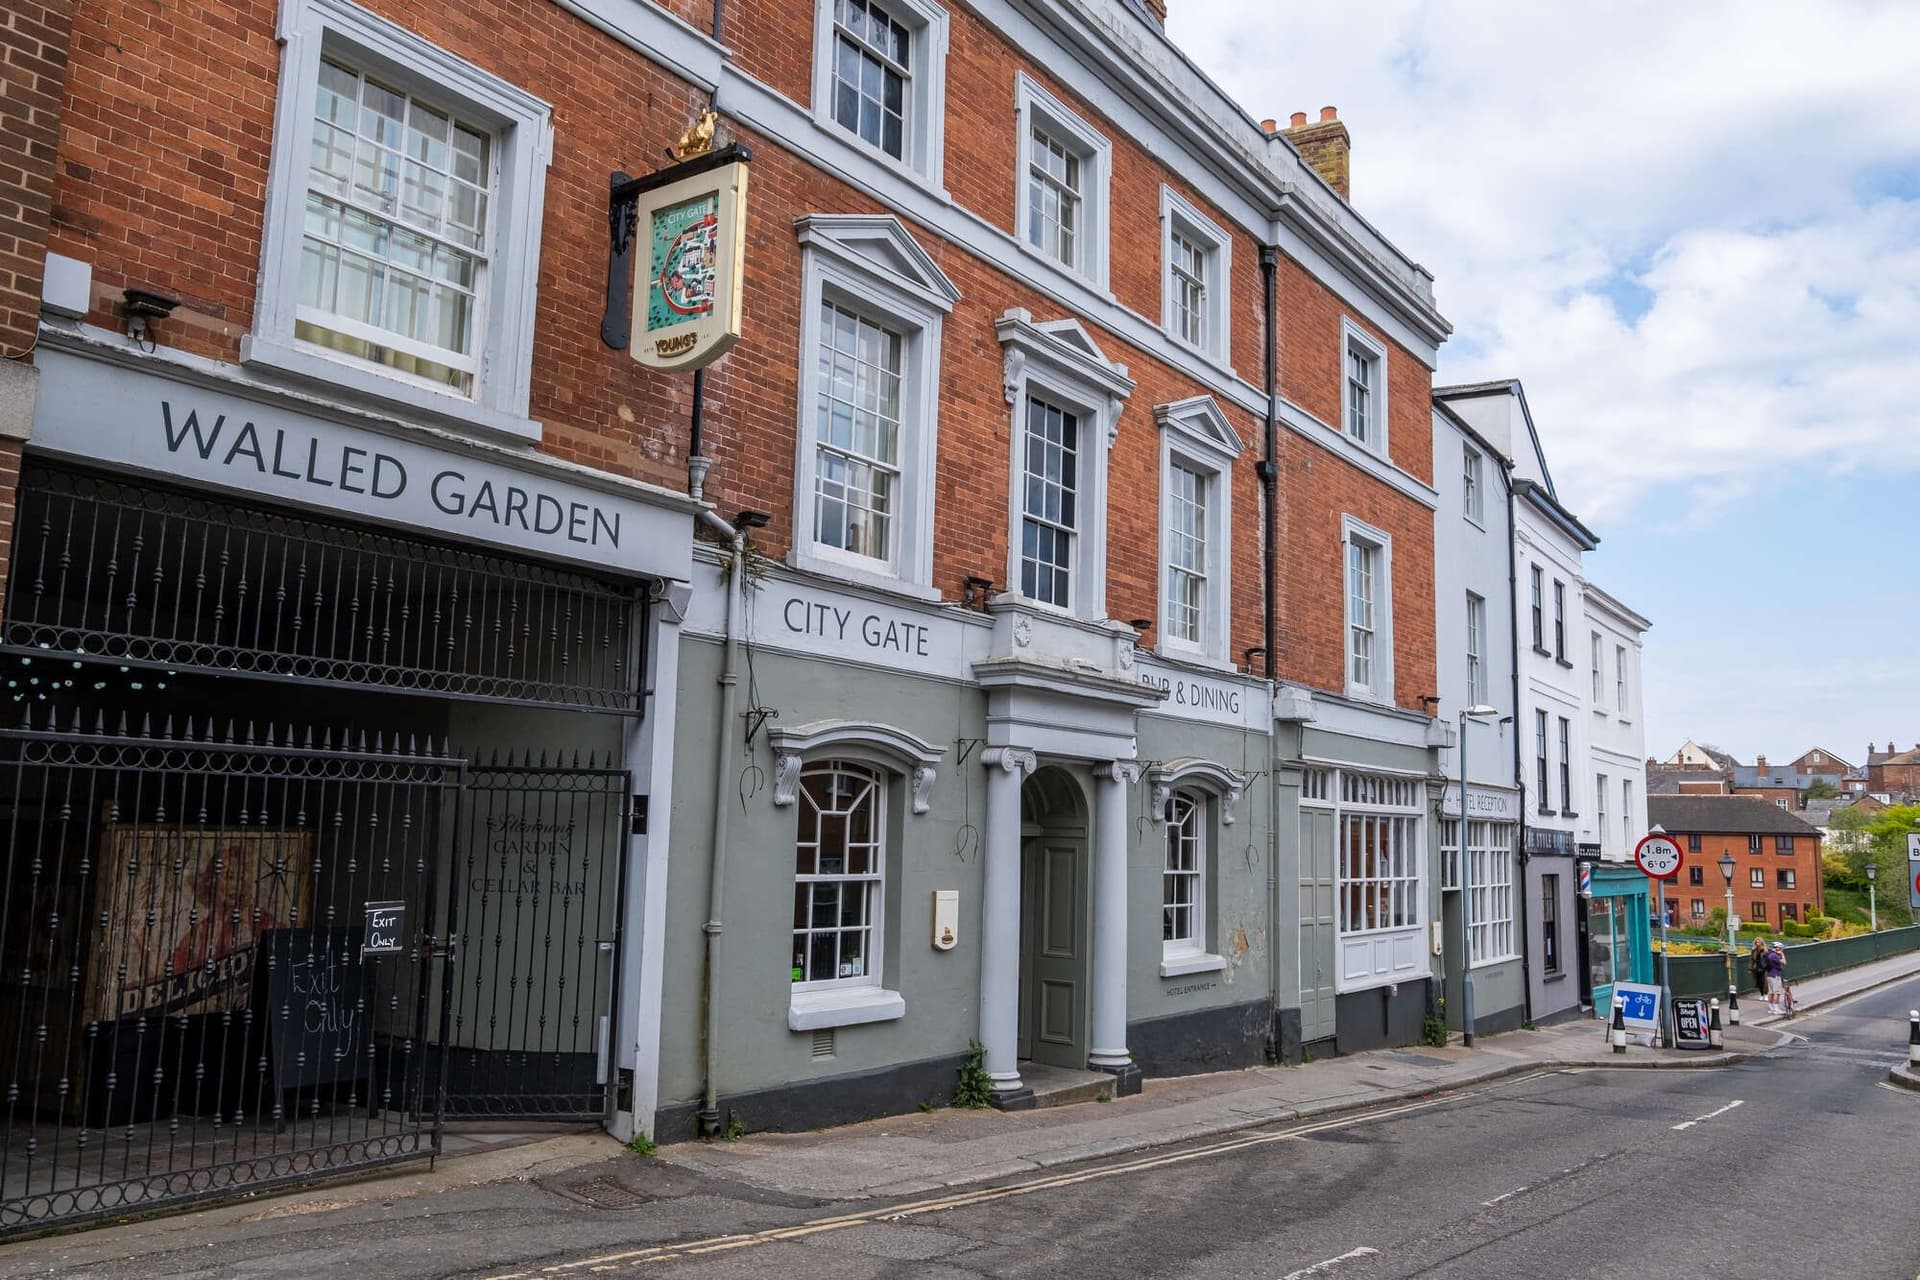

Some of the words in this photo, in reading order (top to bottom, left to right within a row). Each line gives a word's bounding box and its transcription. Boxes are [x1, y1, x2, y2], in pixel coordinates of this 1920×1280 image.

[655, 331, 697, 353] YOUNG'S
[161, 401, 407, 499] WALLED
[430, 470, 621, 551] GARDEN
[784, 598, 851, 640] CITY
[862, 615, 929, 657] GATE
[1176, 681, 1186, 705] &
[1190, 683, 1239, 714] DINING
[1455, 791, 1476, 810] HTEL
[493, 839, 571, 856] GARDEN
[1646, 844, 1672, 855] 1.8m
[523, 860, 536, 874] &
[471, 878, 542, 895] CELLAR
[550, 881, 585, 896] BAR
[291, 947, 340, 994] Exit
[304, 995, 355, 1057] Only
[1681, 1017, 1698, 1028] OPEN
